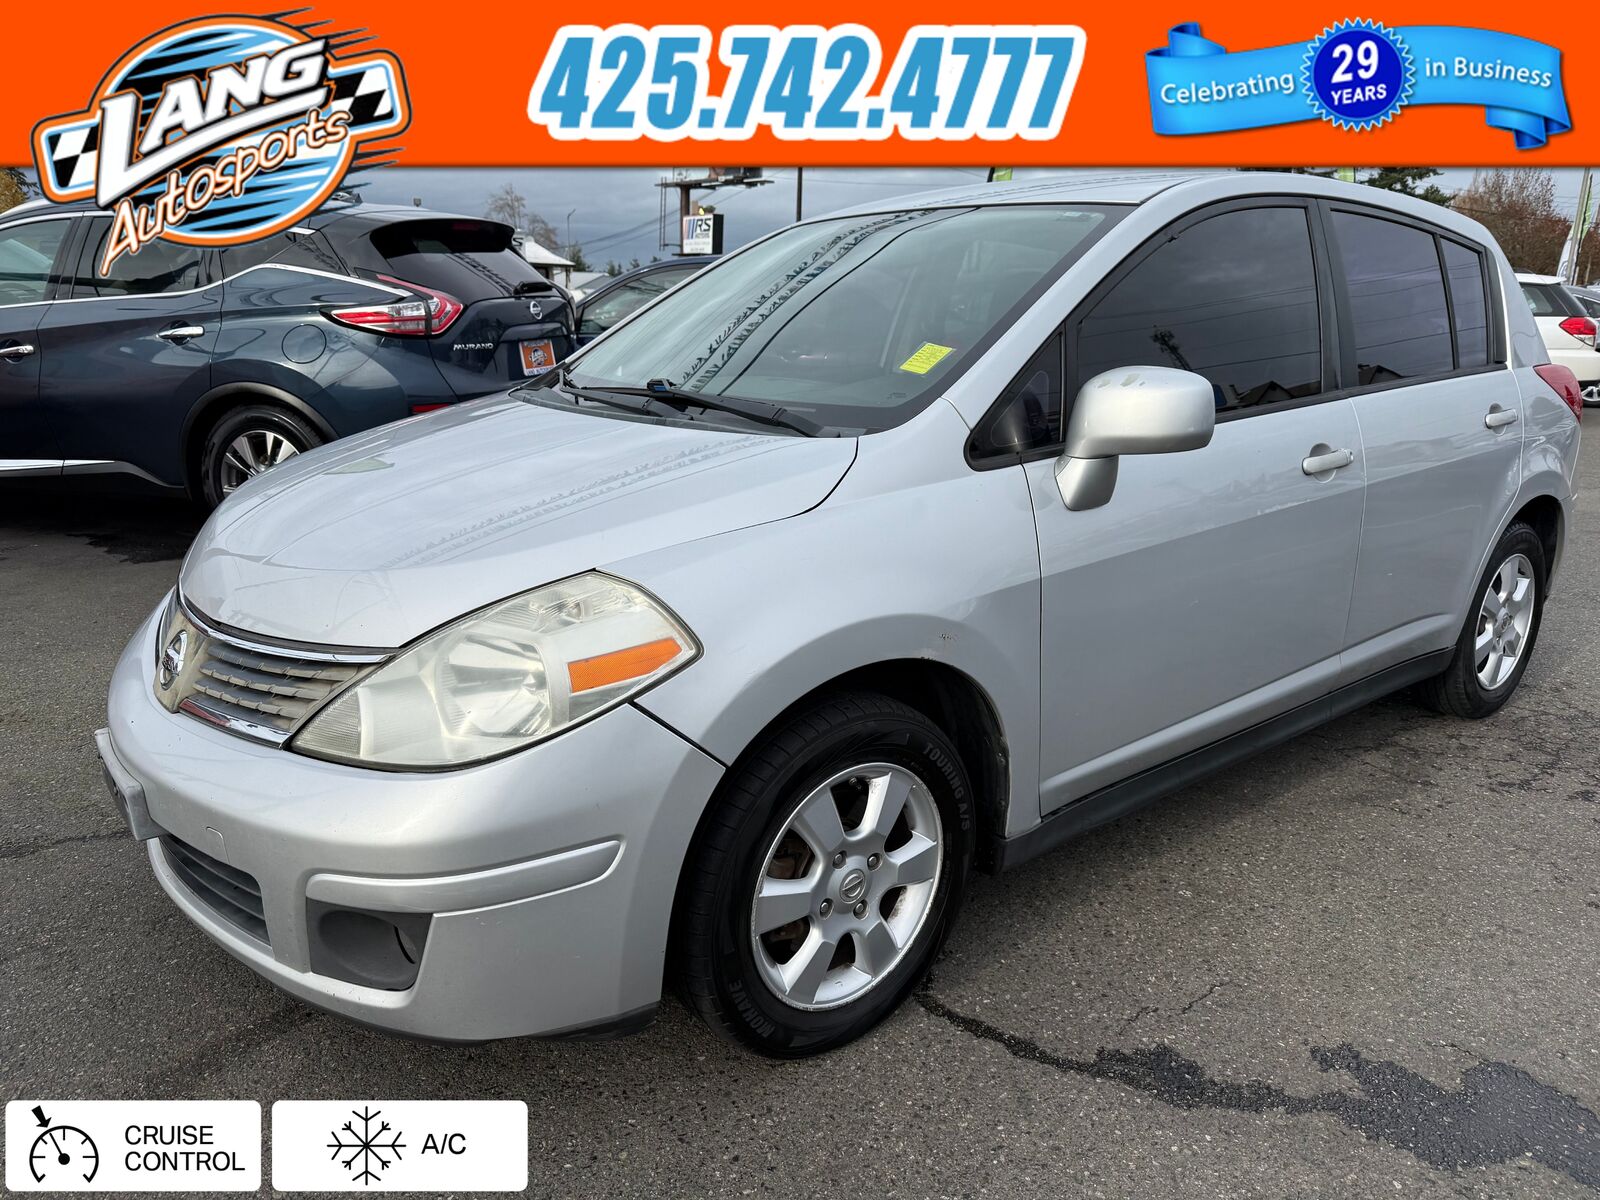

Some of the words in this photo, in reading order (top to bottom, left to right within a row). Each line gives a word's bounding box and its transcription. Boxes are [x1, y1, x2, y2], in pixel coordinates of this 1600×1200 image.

[453, 343, 494, 351] MURANO
[922, 742, 965, 800] TOURING
[728, 978, 776, 1038] MOHAVE
